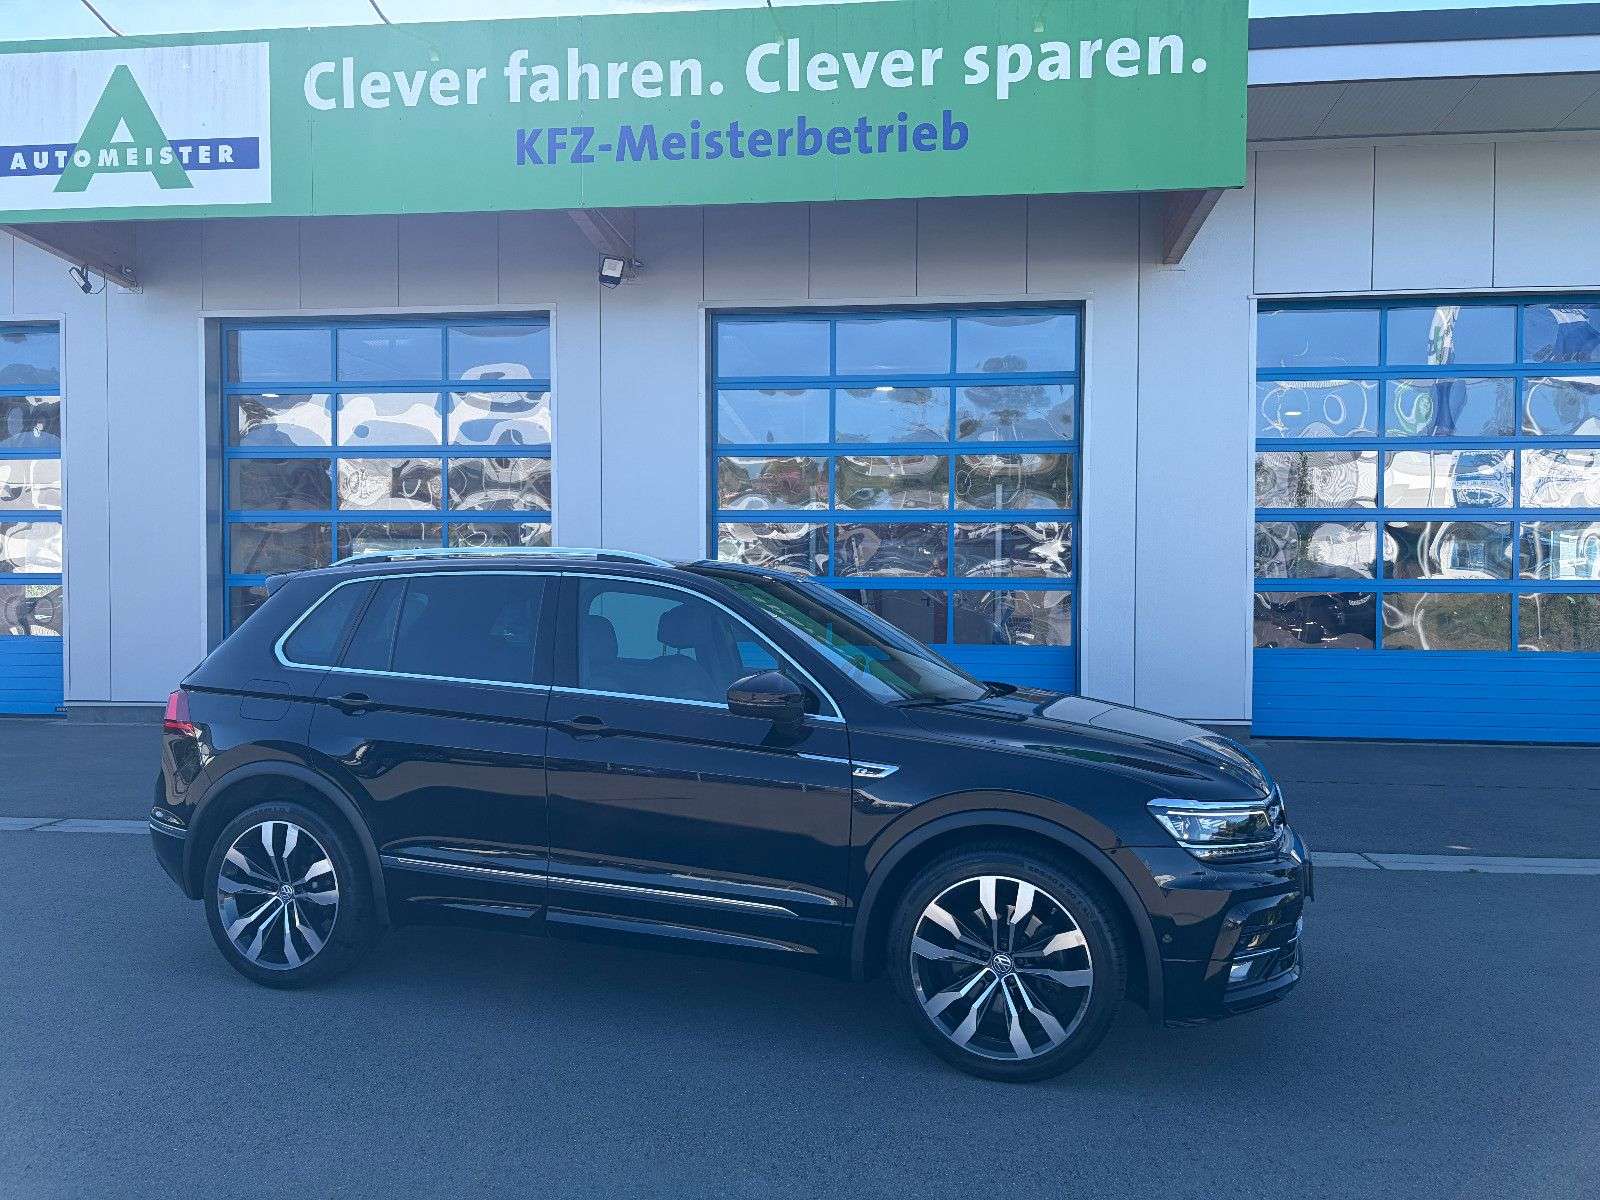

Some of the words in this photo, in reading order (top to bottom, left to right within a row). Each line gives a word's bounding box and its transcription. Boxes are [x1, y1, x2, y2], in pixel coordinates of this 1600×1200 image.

[303, 56, 488, 111] Clever
[503, 47, 724, 103] fahren.
[745, 37, 944, 94] Clever
[963, 34, 1207, 100] sparen.
[10, 144, 235, 170] AUTOMEISTER
[513, 107, 970, 169] KFZ-Meisterbetrieb
